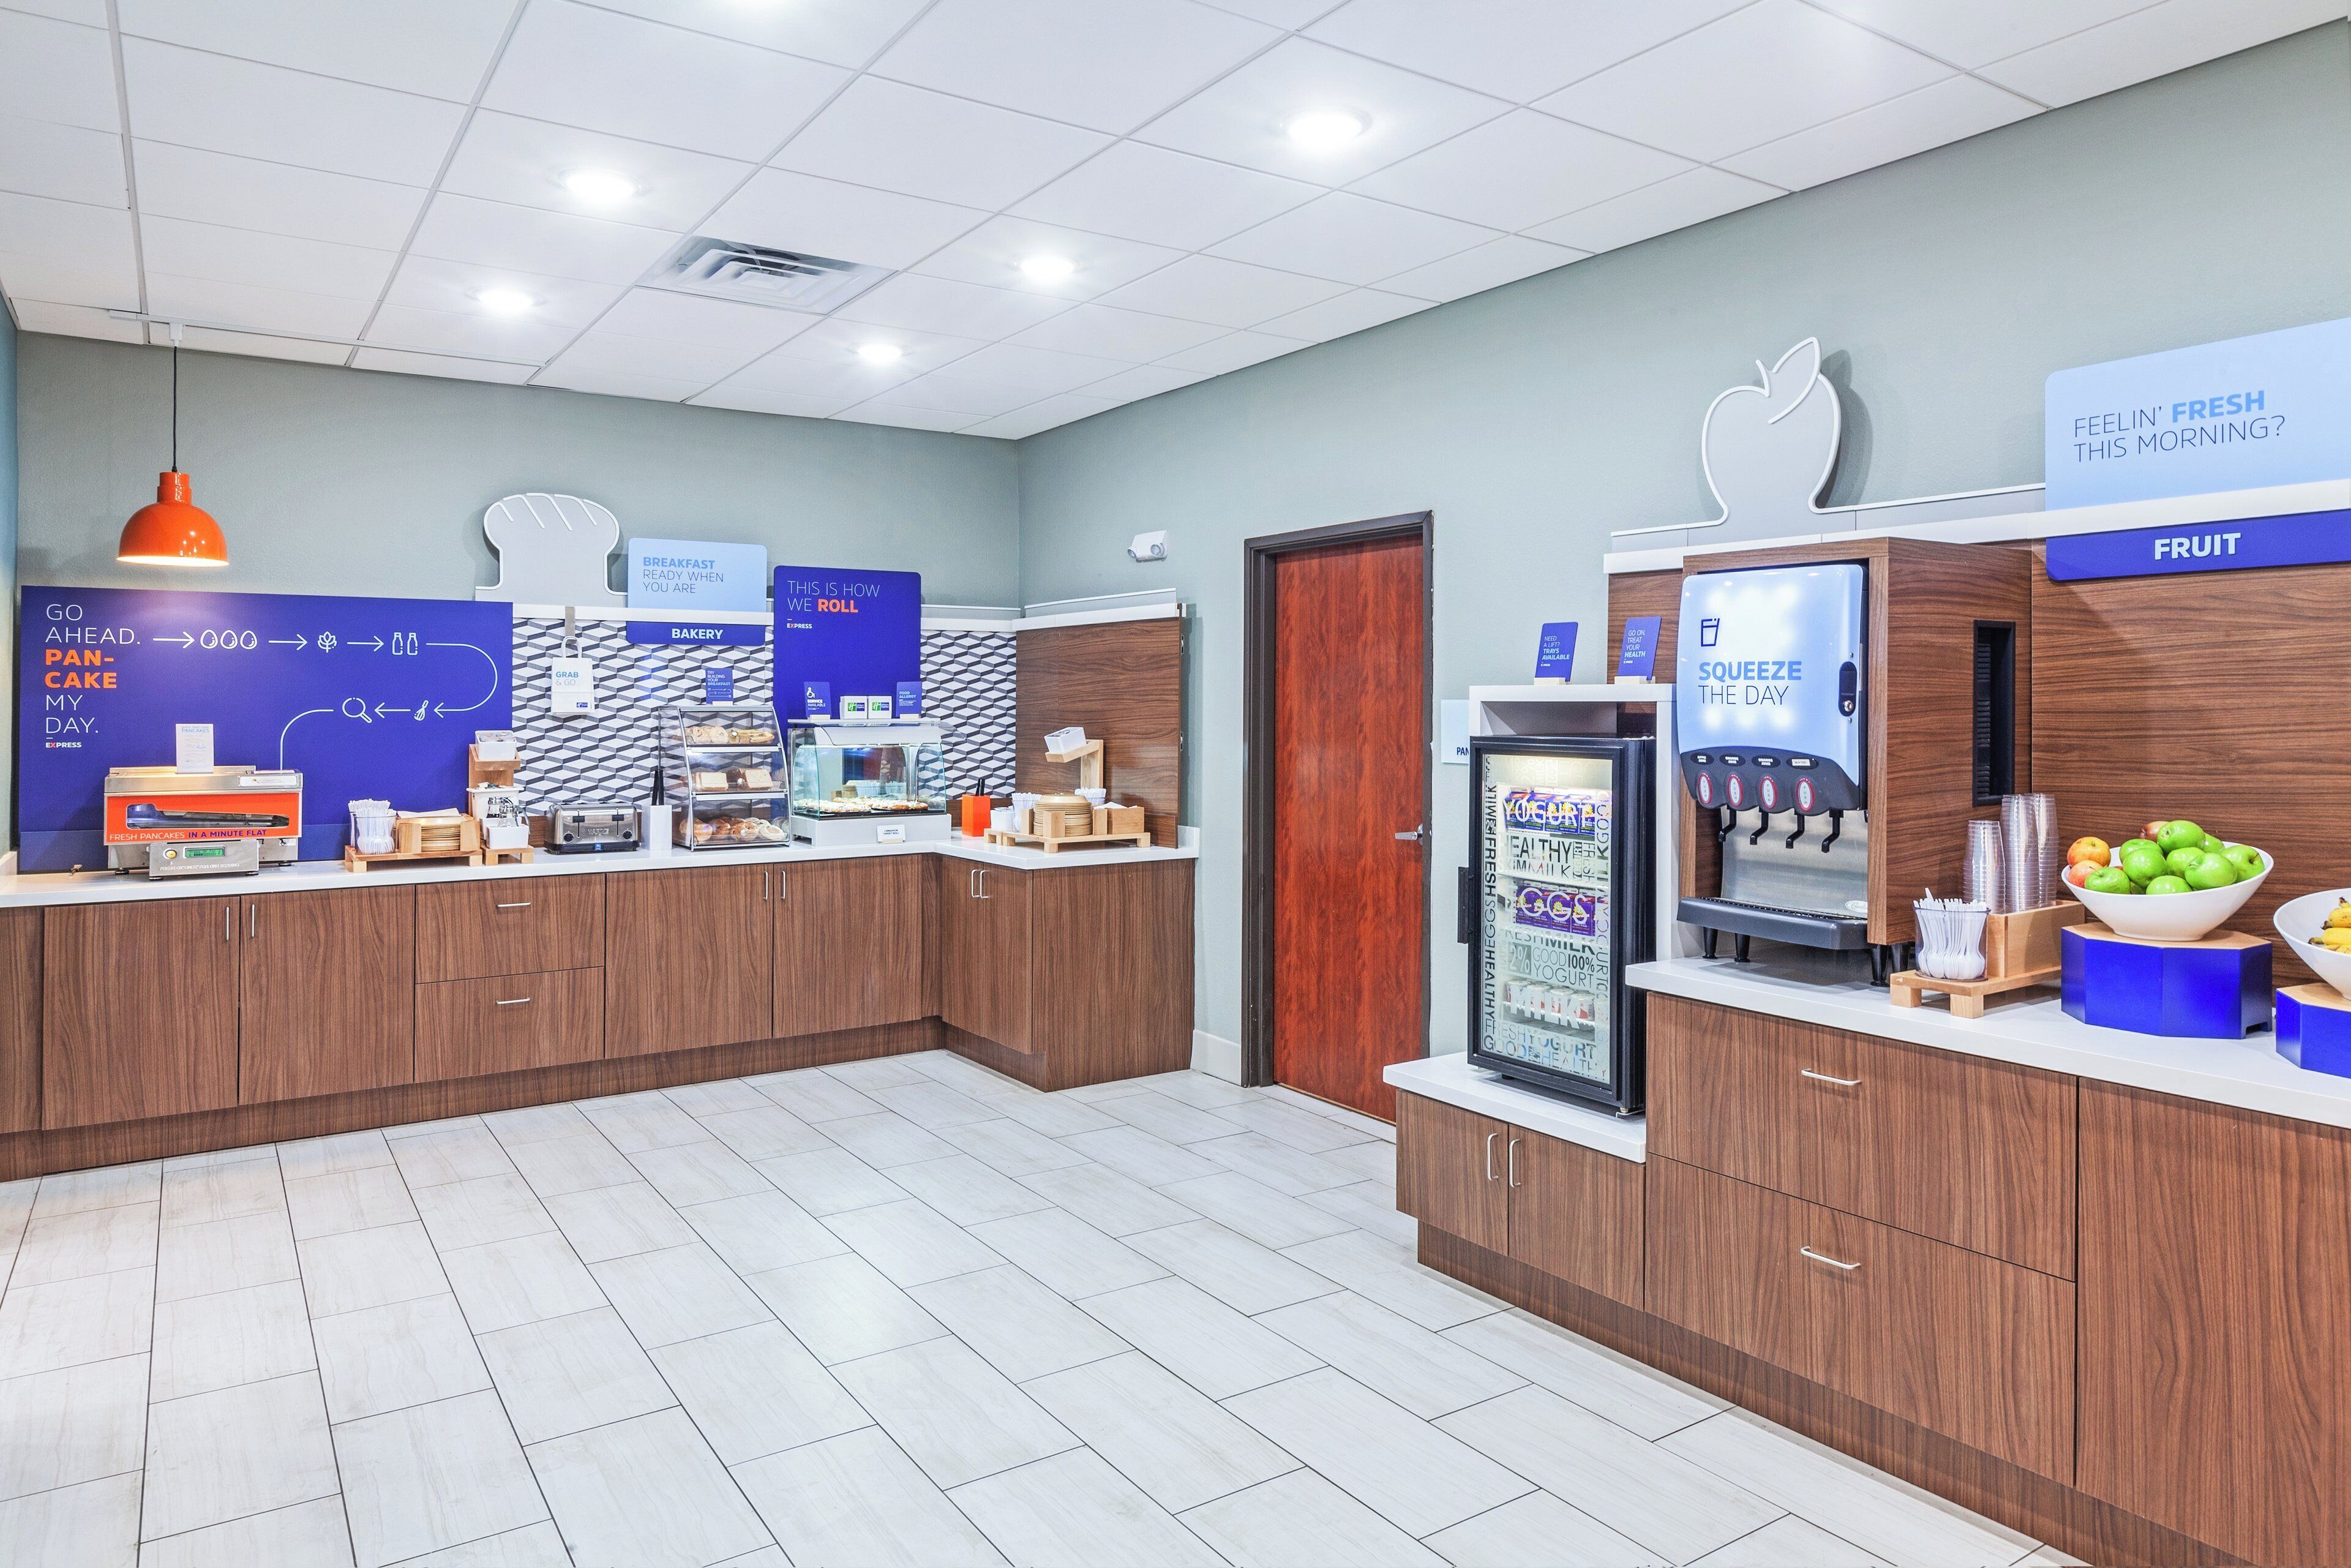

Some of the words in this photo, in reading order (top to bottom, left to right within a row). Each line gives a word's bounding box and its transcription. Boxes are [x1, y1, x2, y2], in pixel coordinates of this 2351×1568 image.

[2172, 390, 2265, 423] FRESH
[2074, 437, 2127, 462] THIS
[2138, 415, 2285, 454] MORNING?
[2154, 532, 2241, 560] FRUIT
[643, 557, 715, 569] BREAKFAST
[643, 569, 683, 580] READY
[687, 571, 724, 582] WHEN
[643, 582, 669, 592] YOU
[673, 583, 696, 593] ARE
[787, 580, 820, 595] THIS
[826, 582, 838, 596] IS
[843, 583, 880, 598] HOW
[46, 604, 83, 621] GO
[787, 598, 812, 612] WE
[817, 598, 858, 613] ROLL
[45, 627, 141, 645] AHEAD.
[672, 628, 724, 640] BAKERY
[45, 649, 114, 666] PAN-
[44, 671, 117, 689] CAKE
[1698, 661, 1802, 683] SQUEEZE
[46, 694, 83, 711] MY
[1698, 685, 1736, 705] THE
[1745, 685, 1789, 705] DAY
[46, 717, 99, 734] DAY.
[1502, 797, 1591, 827] YOGURT
[1485, 837, 1496, 897] FRESH
[1485, 899, 1496, 948] EGGS
[1509, 945, 1531, 973] 2%
[1533, 947, 1567, 966] GOOD
[1568, 953, 1595, 972] 100%
[1485, 950, 1495, 1019] HEALTHY
[1534, 962, 1594, 988] YOGURT
